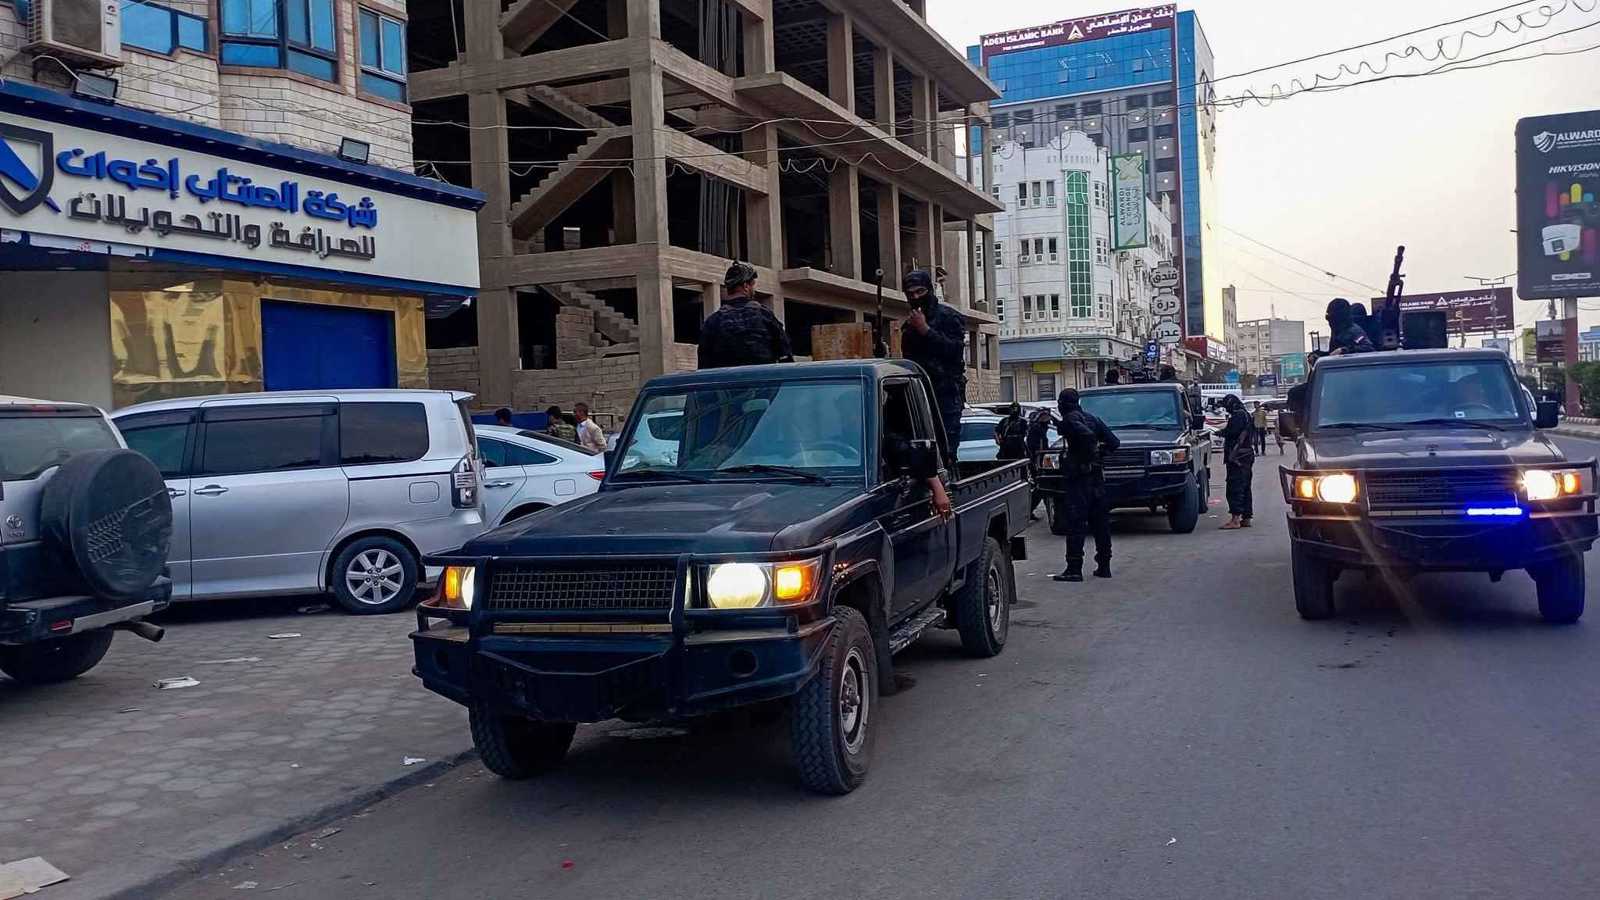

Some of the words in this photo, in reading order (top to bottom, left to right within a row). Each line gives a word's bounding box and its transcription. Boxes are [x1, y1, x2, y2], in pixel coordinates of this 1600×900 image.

[983, 36, 1005, 47] ADEN
[1006, 31, 1040, 43] ISLAMIC
[1041, 27, 1065, 38] BANK
[56, 148, 180, 200] إخوان
[67, 192, 261, 250] والتحويلات
[302, 189, 377, 229] شركة
[269, 221, 376, 261] للصرافة
[1152, 270, 1178, 284] فندق
[1157, 300, 1176, 312] درة
